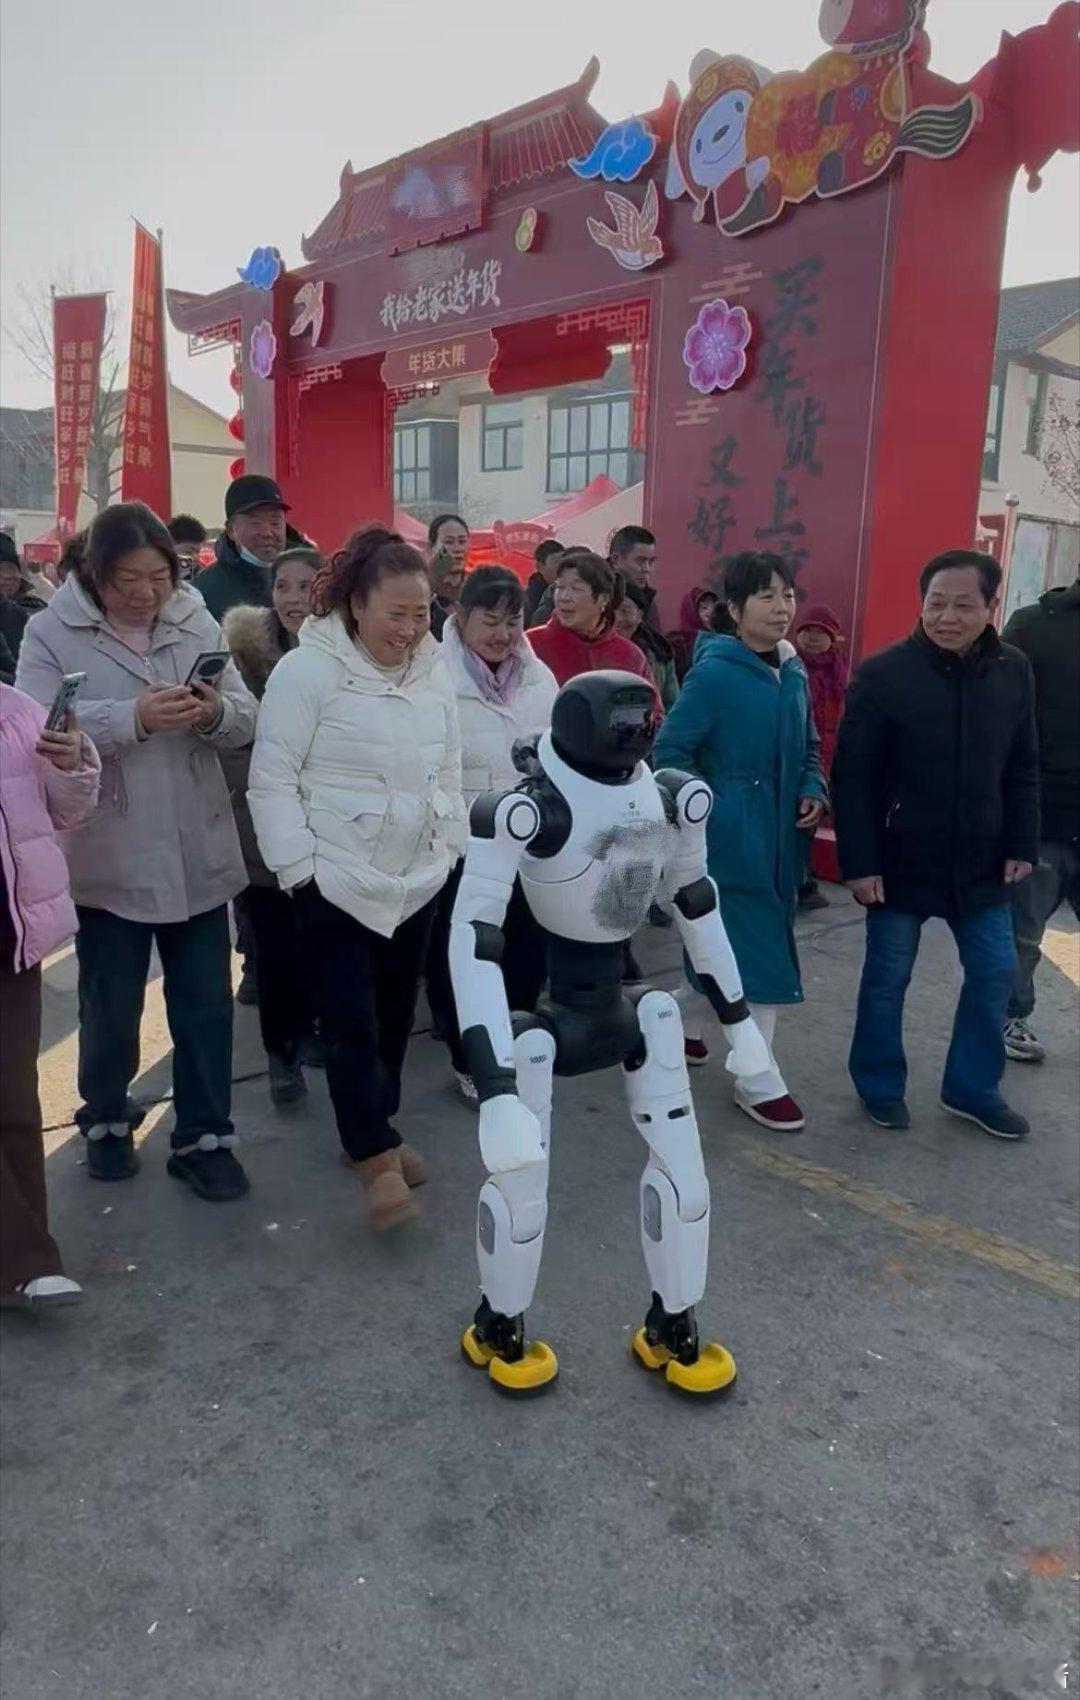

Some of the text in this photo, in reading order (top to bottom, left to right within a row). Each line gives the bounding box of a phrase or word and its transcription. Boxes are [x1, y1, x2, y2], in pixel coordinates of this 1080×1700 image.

[380, 259, 502, 332] 我给老家送年货
